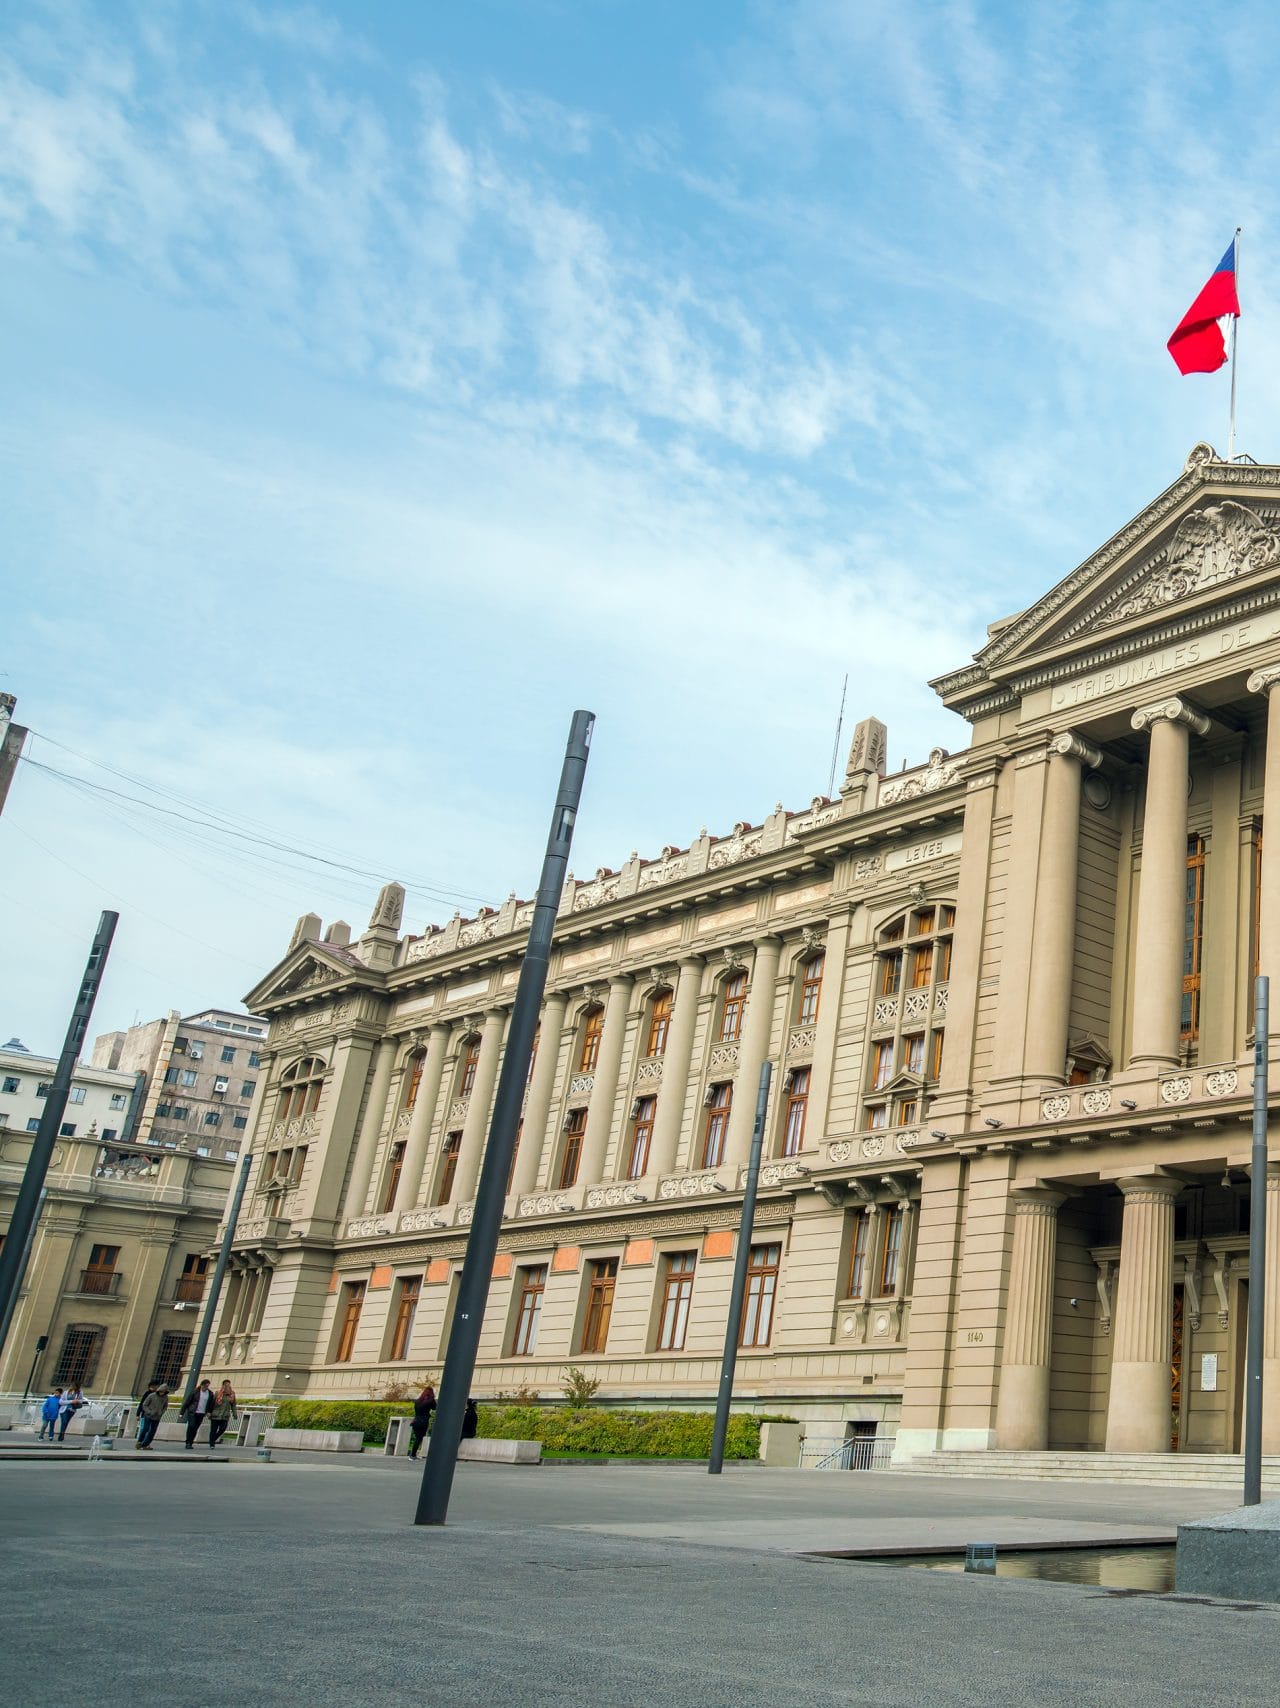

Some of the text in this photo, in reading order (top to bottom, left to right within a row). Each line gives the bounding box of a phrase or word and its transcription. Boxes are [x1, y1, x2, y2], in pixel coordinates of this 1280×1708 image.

[1071, 642, 1200, 703] TRIBUNALES
[1219, 625, 1251, 654] DE
[906, 841, 943, 863] LEYES
[967, 1332, 984, 1343] 1140
